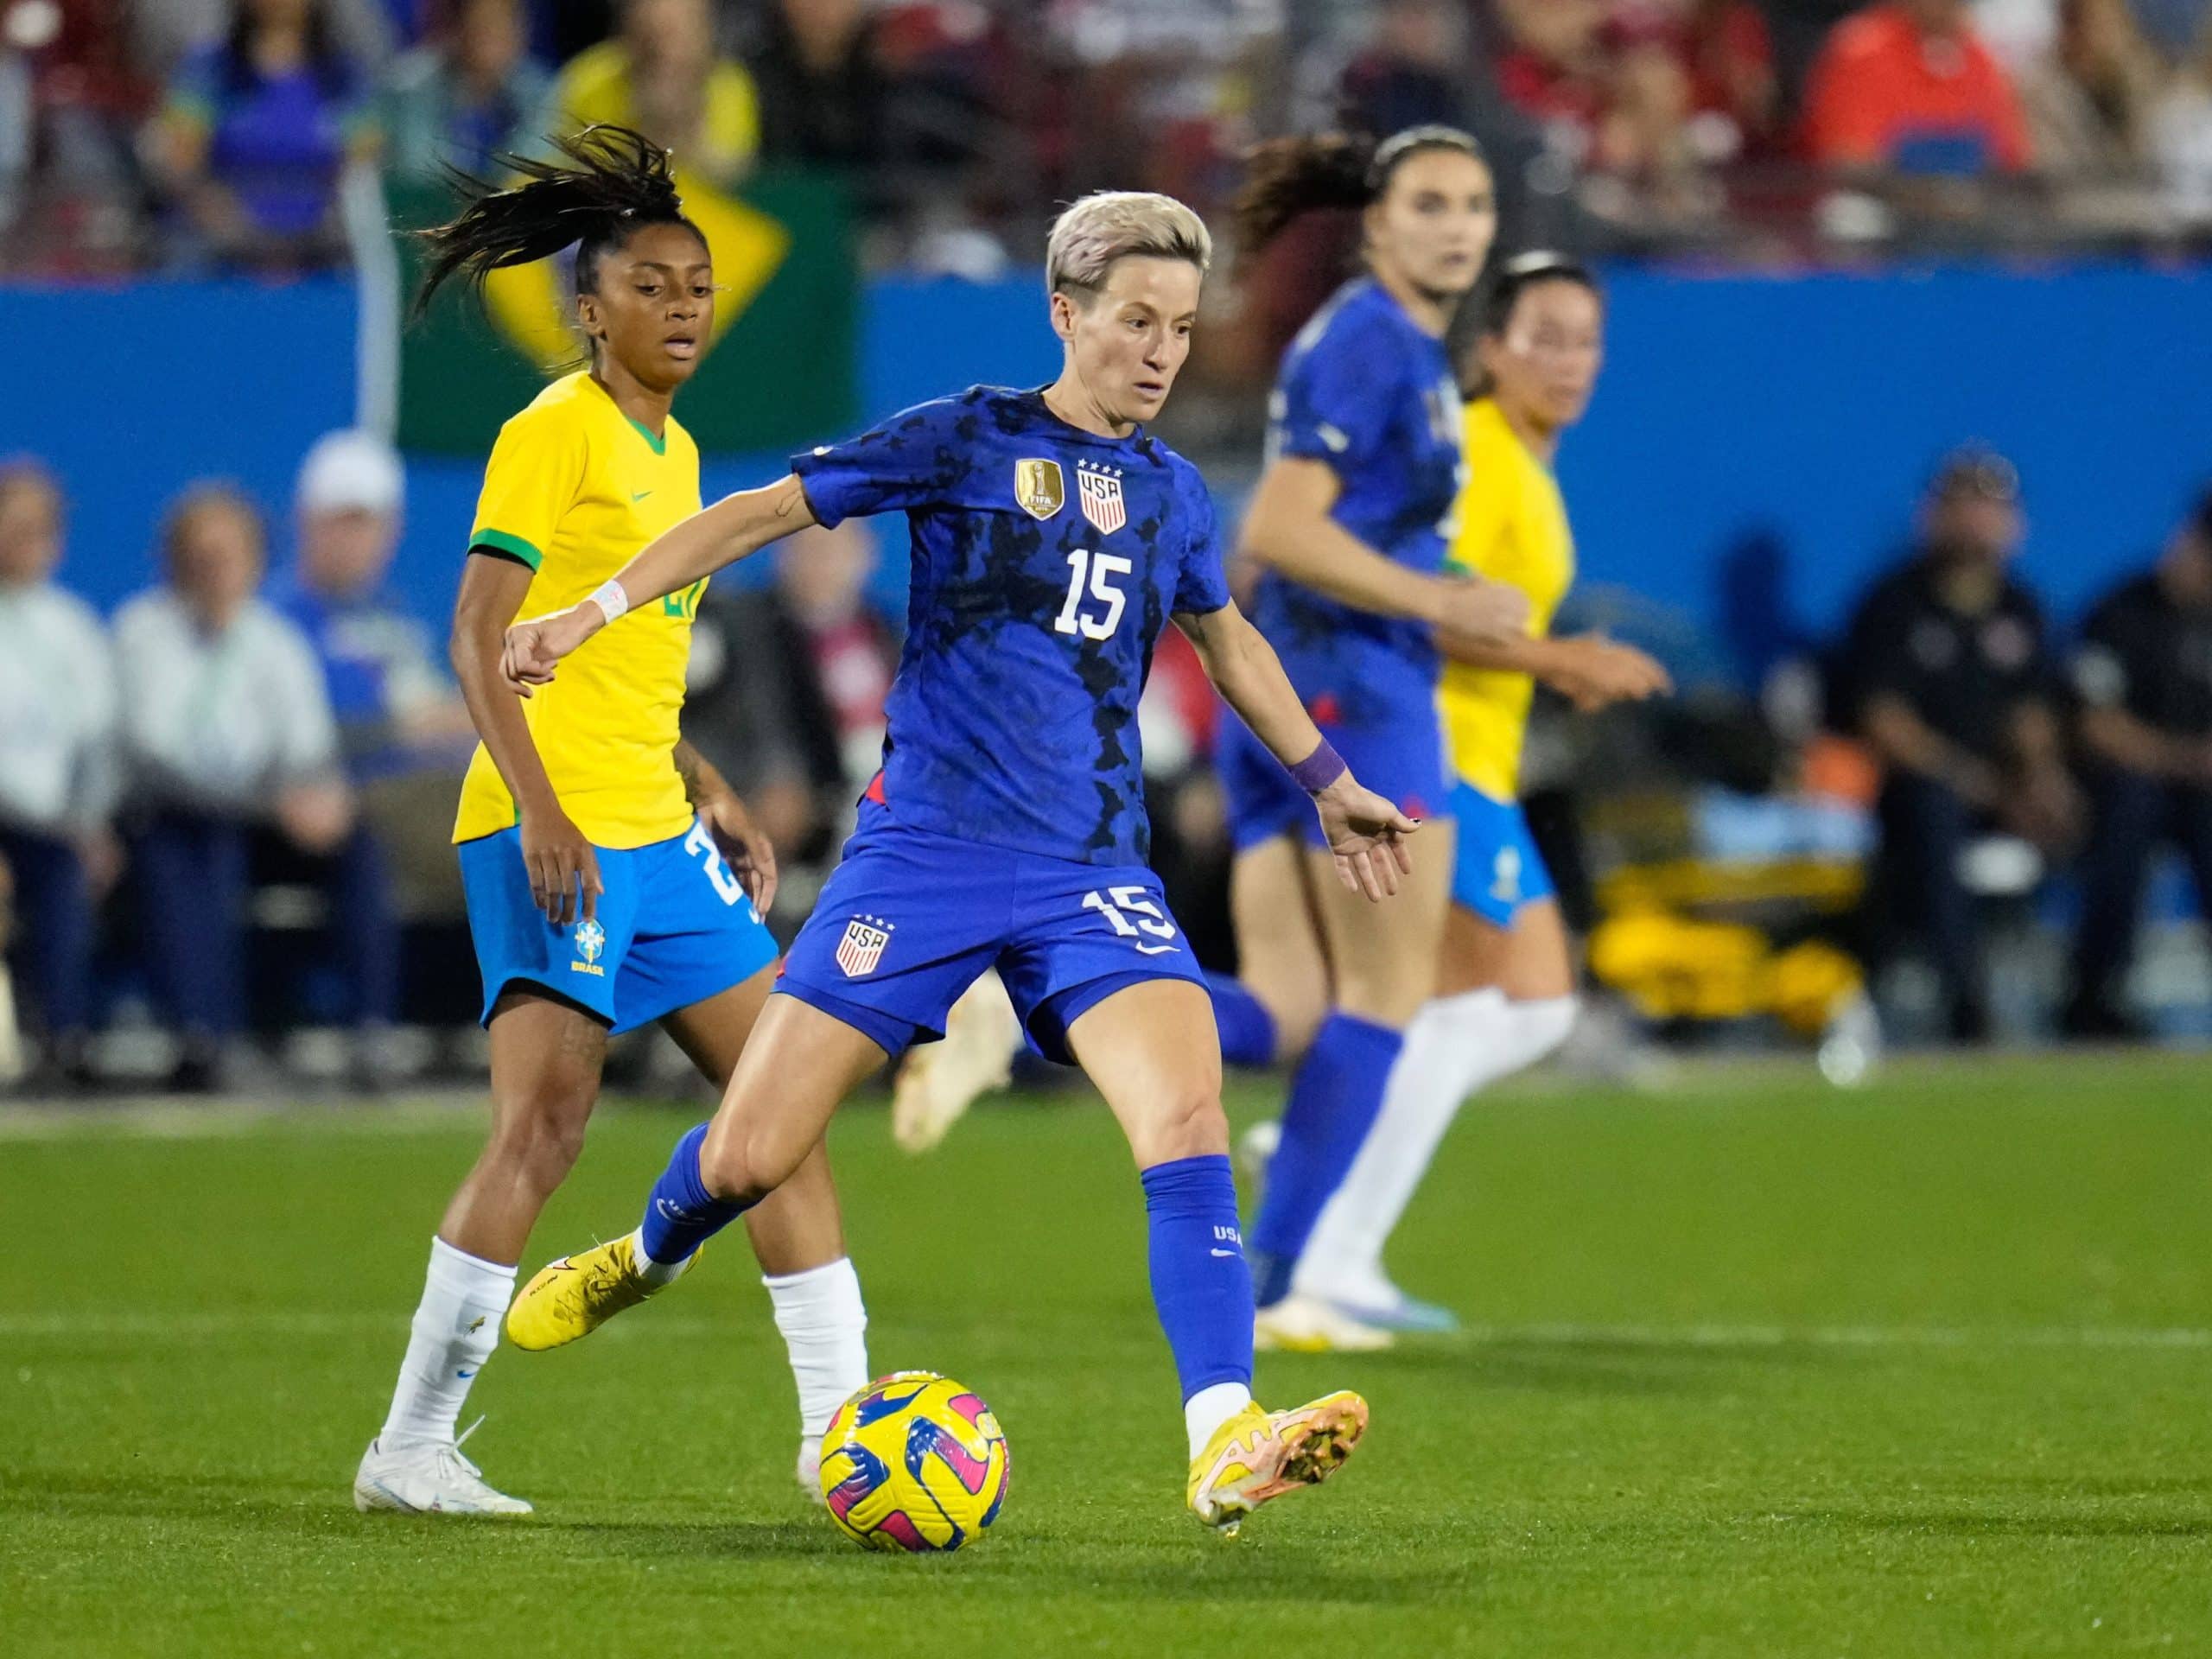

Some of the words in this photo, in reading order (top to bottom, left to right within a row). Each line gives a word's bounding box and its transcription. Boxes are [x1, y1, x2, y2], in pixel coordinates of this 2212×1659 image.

[1081, 474, 1119, 499] USA
[1054, 549, 1132, 640] 15
[1082, 886, 1176, 941] 15
[849, 924, 884, 947] USA
